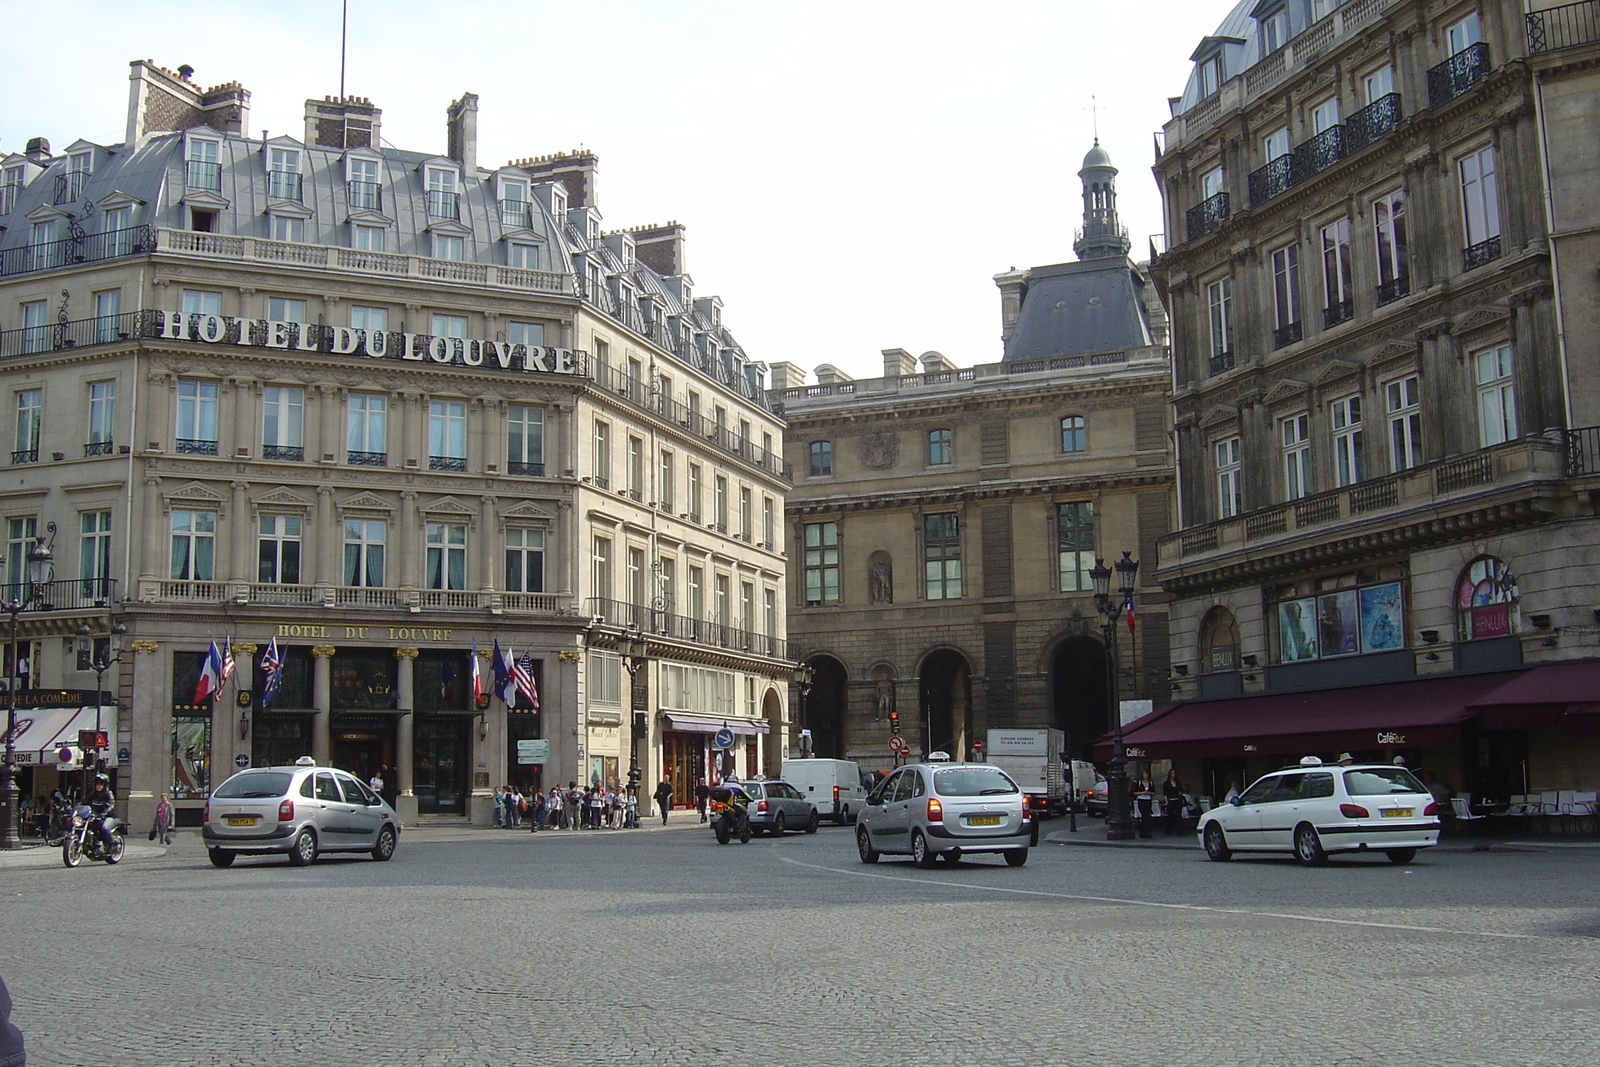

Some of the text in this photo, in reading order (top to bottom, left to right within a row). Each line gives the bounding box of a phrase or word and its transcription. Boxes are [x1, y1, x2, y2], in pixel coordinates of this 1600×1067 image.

[160, 310, 576, 374] HOTEL DU LOUVRE
[1476, 613, 1506, 632] BENLUX
[278, 625, 452, 641] HOTEL DU LOUVRE
[1213, 652, 1233, 668] BENLUX
[26, 694, 39, 704] LA
